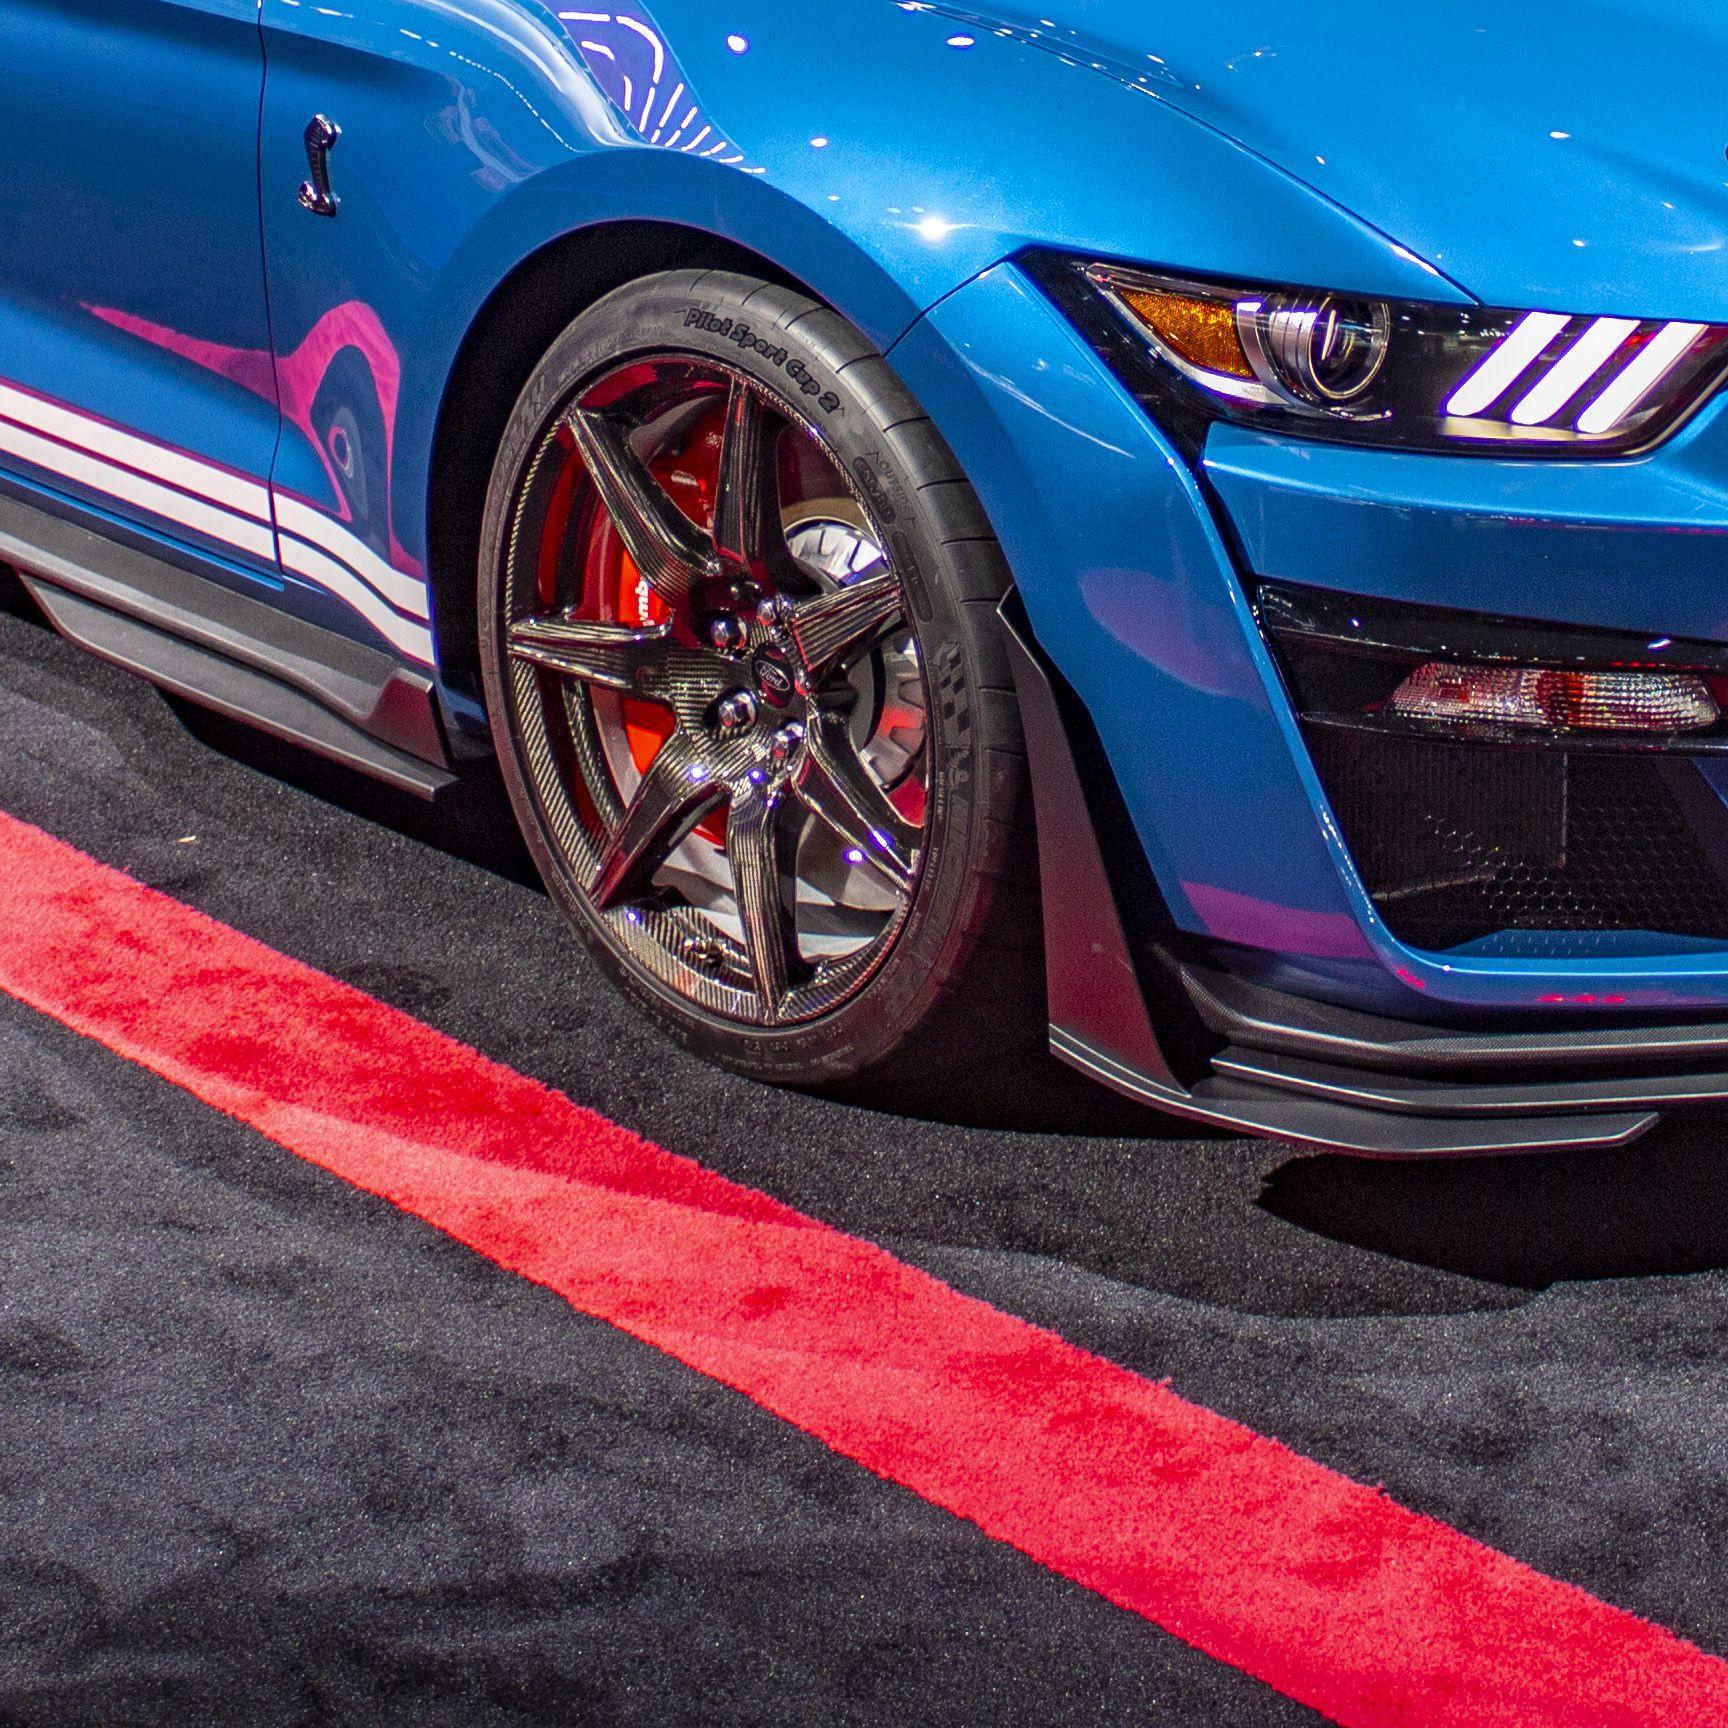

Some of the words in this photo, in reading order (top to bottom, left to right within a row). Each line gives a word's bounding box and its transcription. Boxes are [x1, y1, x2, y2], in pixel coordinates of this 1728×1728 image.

[684, 308, 734, 336] Pilot
[731, 323, 789, 368] Sport
[785, 357, 821, 396] Cup
[817, 390, 841, 414] 2
